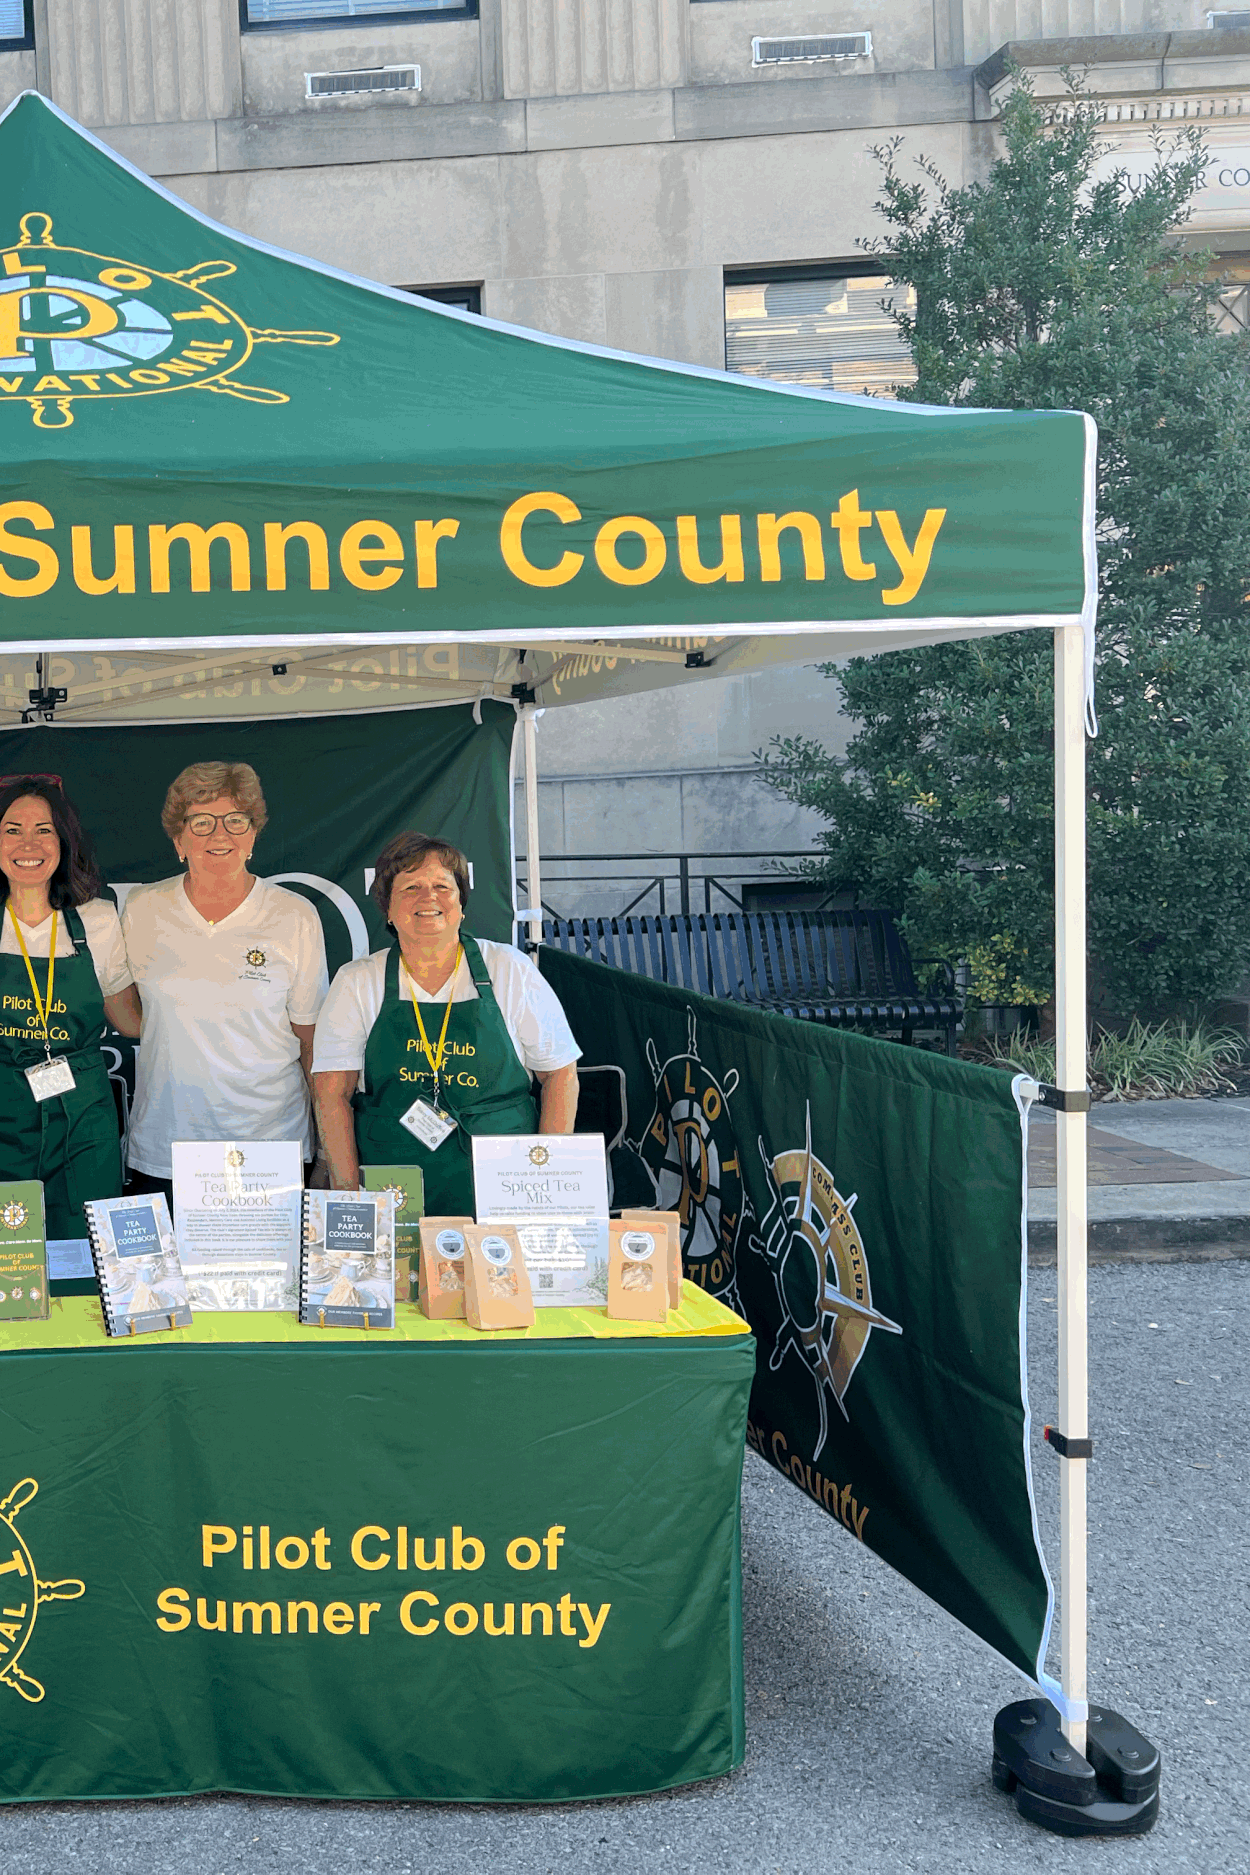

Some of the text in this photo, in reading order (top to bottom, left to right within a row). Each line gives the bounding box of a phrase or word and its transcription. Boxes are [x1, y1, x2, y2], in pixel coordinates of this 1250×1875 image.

[500, 490, 946, 607] County
[3, 995, 67, 1013] Pilot Cub
[26, 1014, 41, 1027] of
[50, 1026, 70, 1041] Co.
[442, 1041, 476, 1056] Club
[399, 1067, 479, 1087] Sumr Co.
[651, 1061, 740, 1178] PILOT
[200, 1181, 269, 1195] Tea Party
[501, 1179, 581, 1196] Spiced Tea
[202, 1194, 273, 1207] Cookbook
[526, 1192, 553, 1204] Mix
[125, 1220, 140, 1228] TEA
[117, 1233, 157, 1246] COOKBOOK
[123, 1228, 147, 1237] PARTY
[329, 1231, 373, 1240] COOKBOOK
[812, 1167, 863, 1300] COMASS CLUB
[17, 1252, 34, 1260] CLUB
[220, 1270, 236, 1278] paid
[771, 1431, 869, 1543] County
[203, 1525, 566, 1571] Pilot Club of
[157, 1588, 610, 1648] Sumner County
